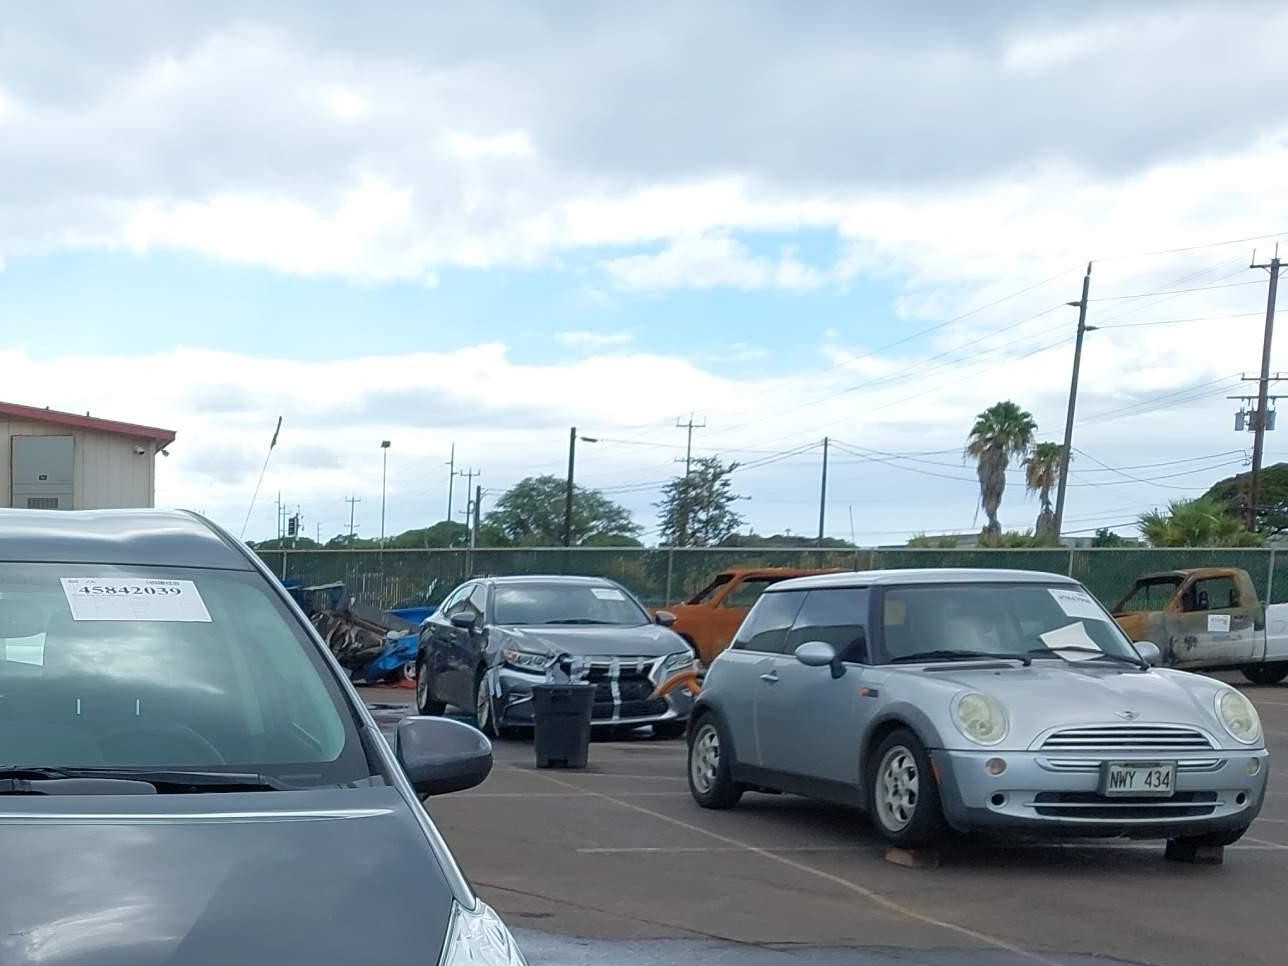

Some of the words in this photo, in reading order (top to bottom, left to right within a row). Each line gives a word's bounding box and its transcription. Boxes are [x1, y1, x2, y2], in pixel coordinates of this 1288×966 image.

[79, 586, 181, 596] 45842039
[1110, 771, 1137, 788] NWY
[1144, 771, 1170, 788] 434
